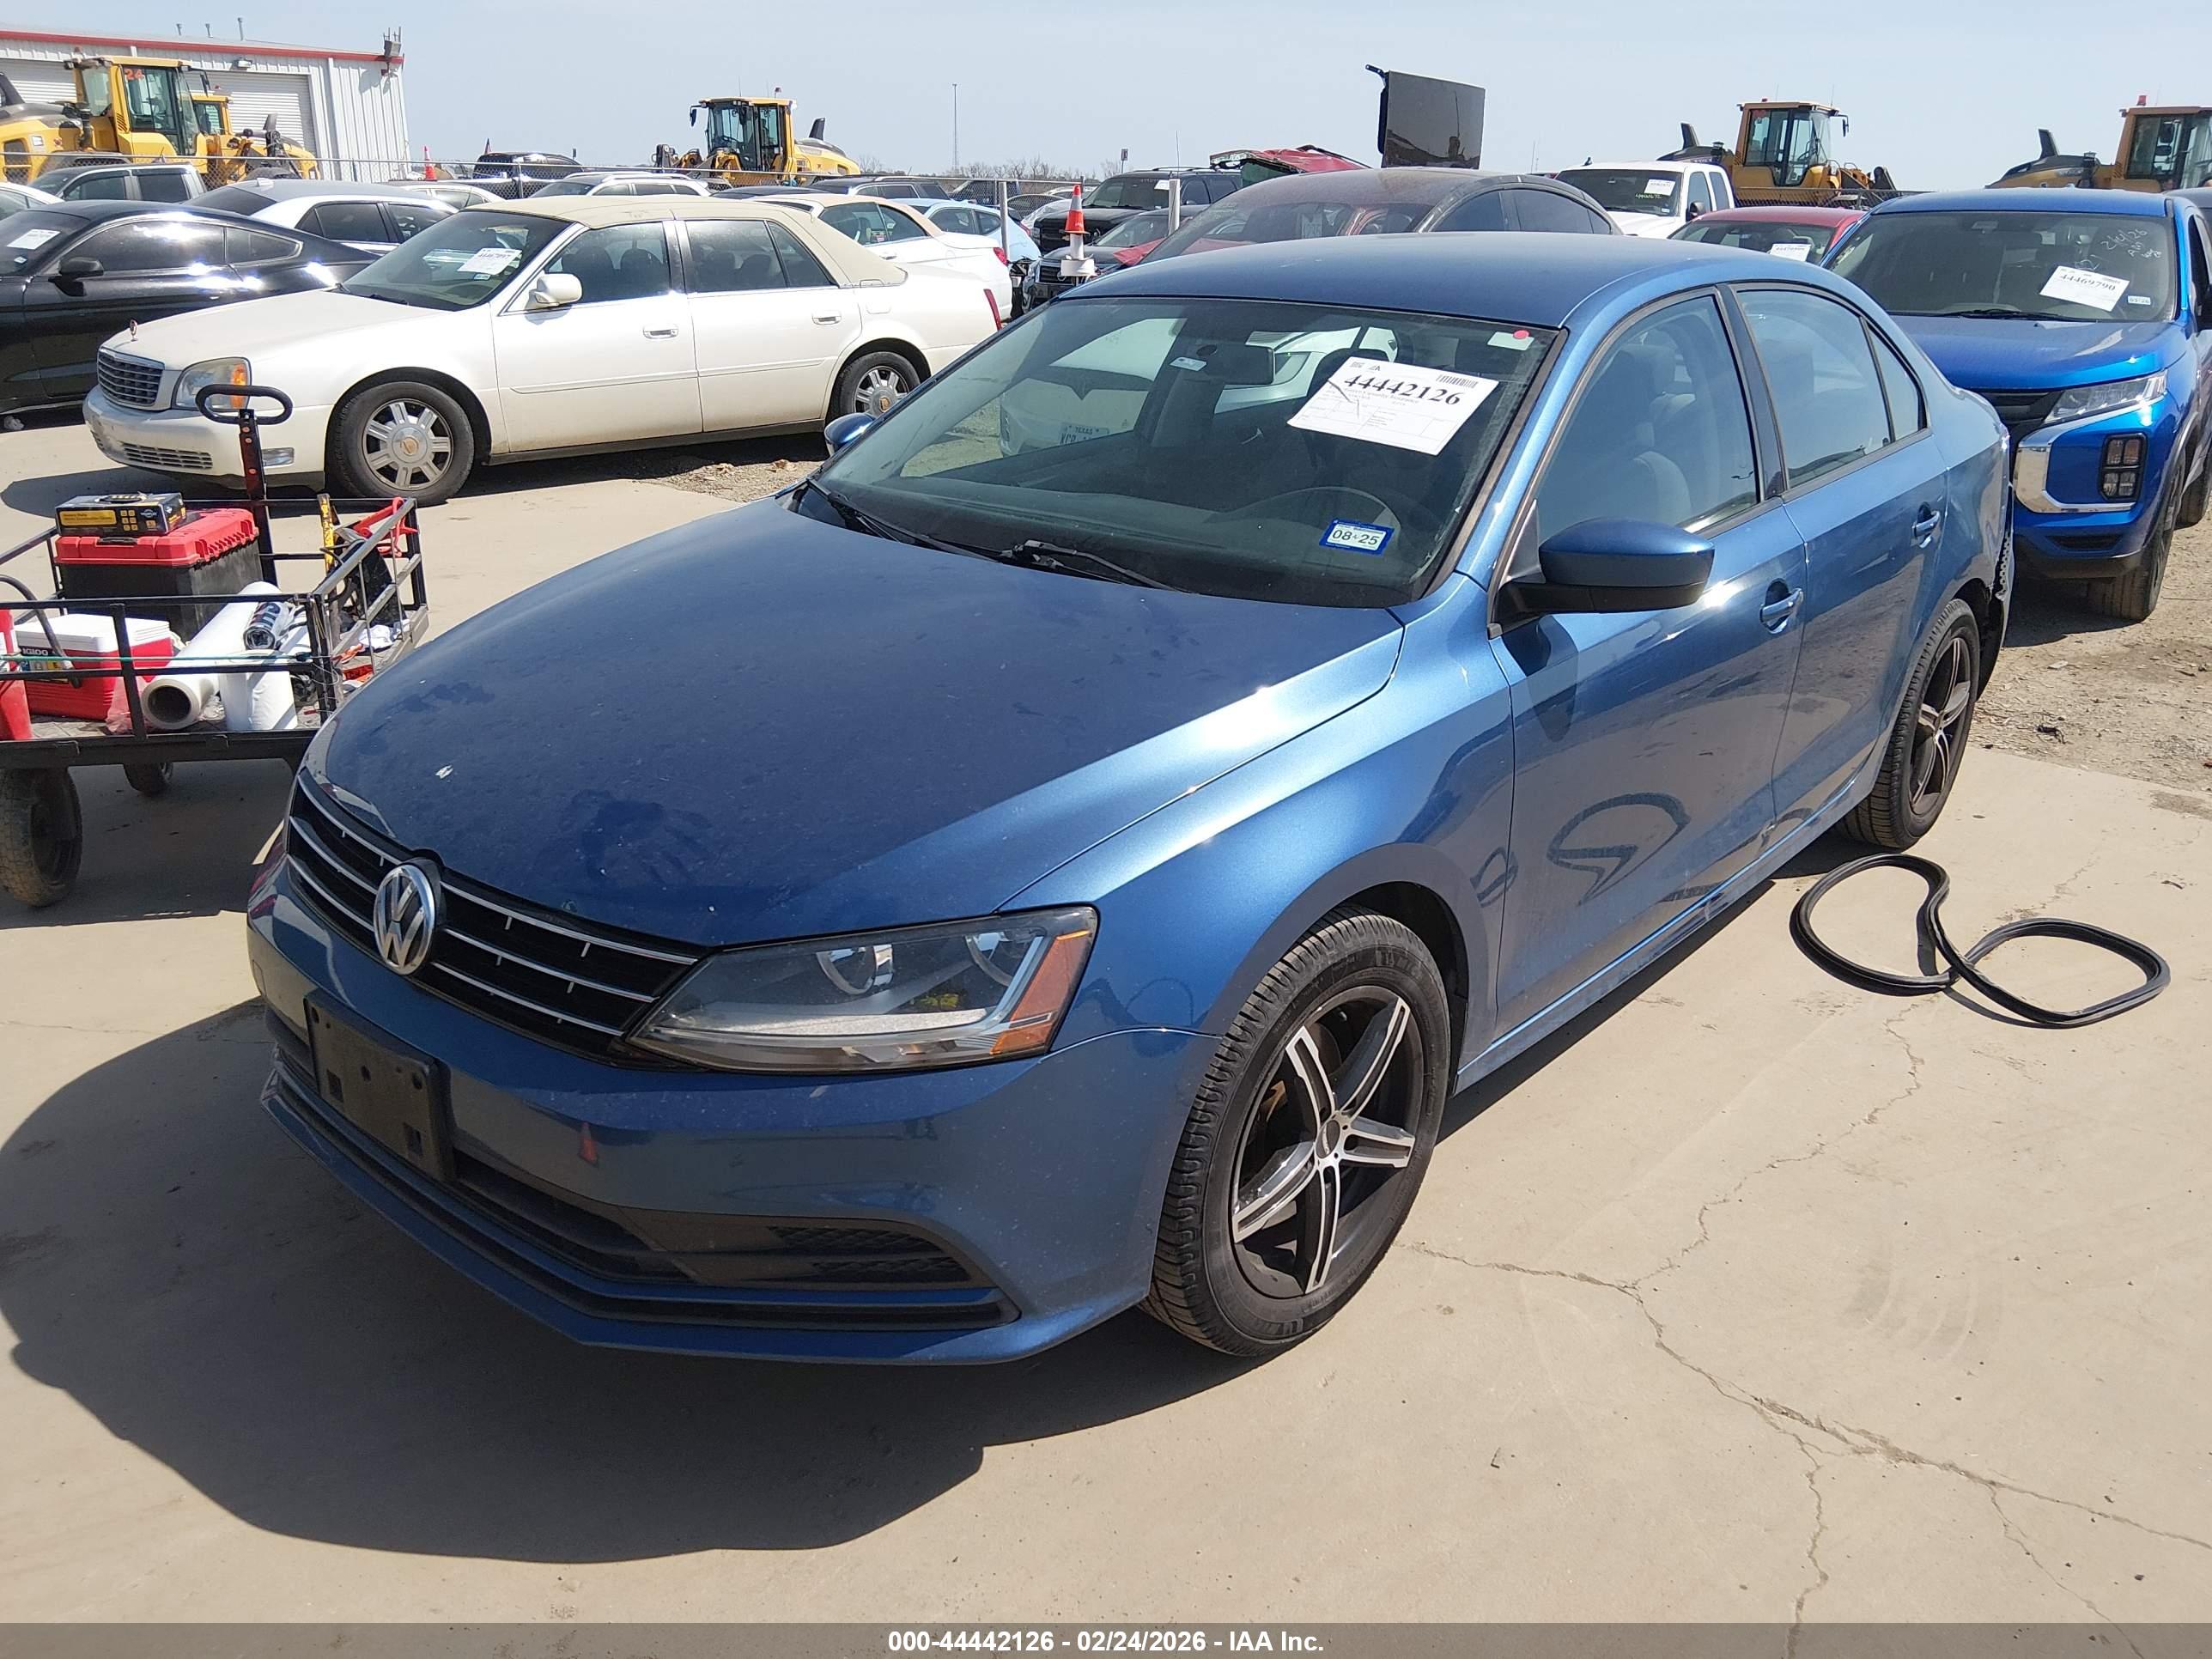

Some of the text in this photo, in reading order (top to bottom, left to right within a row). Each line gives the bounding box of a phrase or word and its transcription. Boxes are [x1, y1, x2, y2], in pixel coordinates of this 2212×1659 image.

[2061, 274, 2116, 291] 44469790
[1344, 374, 1465, 405] 44442126
[22, 647, 49, 656] IGLOO
